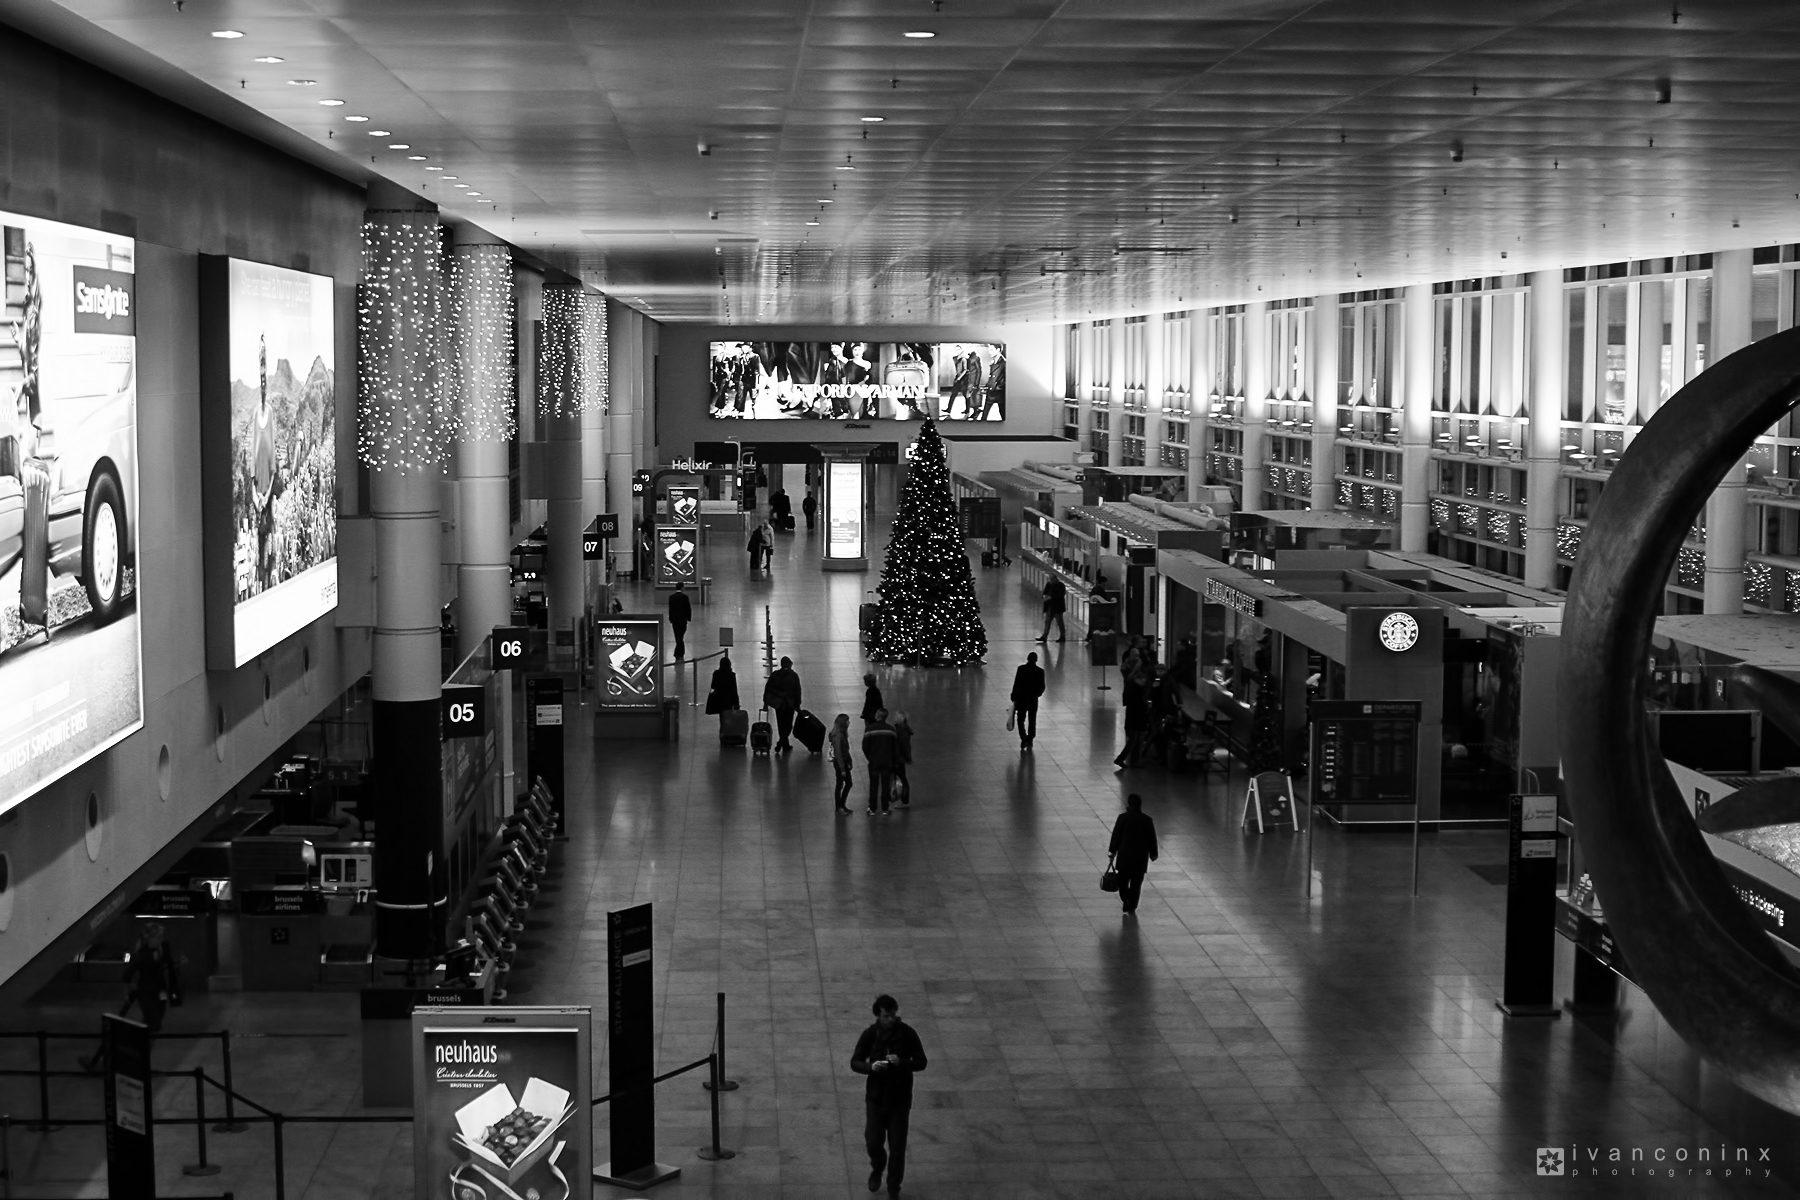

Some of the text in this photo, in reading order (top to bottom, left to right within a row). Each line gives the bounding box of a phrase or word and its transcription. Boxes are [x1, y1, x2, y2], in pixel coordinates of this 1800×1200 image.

[76, 281, 130, 320] Samsonite
[793, 383, 926, 399] EMPORIO ARMANI
[672, 457, 713, 474] Helixir
[633, 483, 643, 492] 09
[602, 521, 615, 532] 08
[584, 541, 598, 553] 07
[1206, 577, 1256, 617] STARBUCKS COFFEE
[601, 626, 627, 636] neuhaus
[1382, 614, 1418, 651] STARBUCKS COFFEE
[500, 640, 523, 658] 06
[449, 702, 476, 723] 05
[71, 709, 88, 737] EVER
[162, 894, 191, 902] brussels
[162, 902, 188, 910] airlines
[274, 895, 303, 903] brussels
[274, 903, 301, 911] airlines
[614, 930, 622, 996] ALLIANCE
[427, 994, 461, 1002] brussels
[435, 1039, 498, 1063] neuhaus
